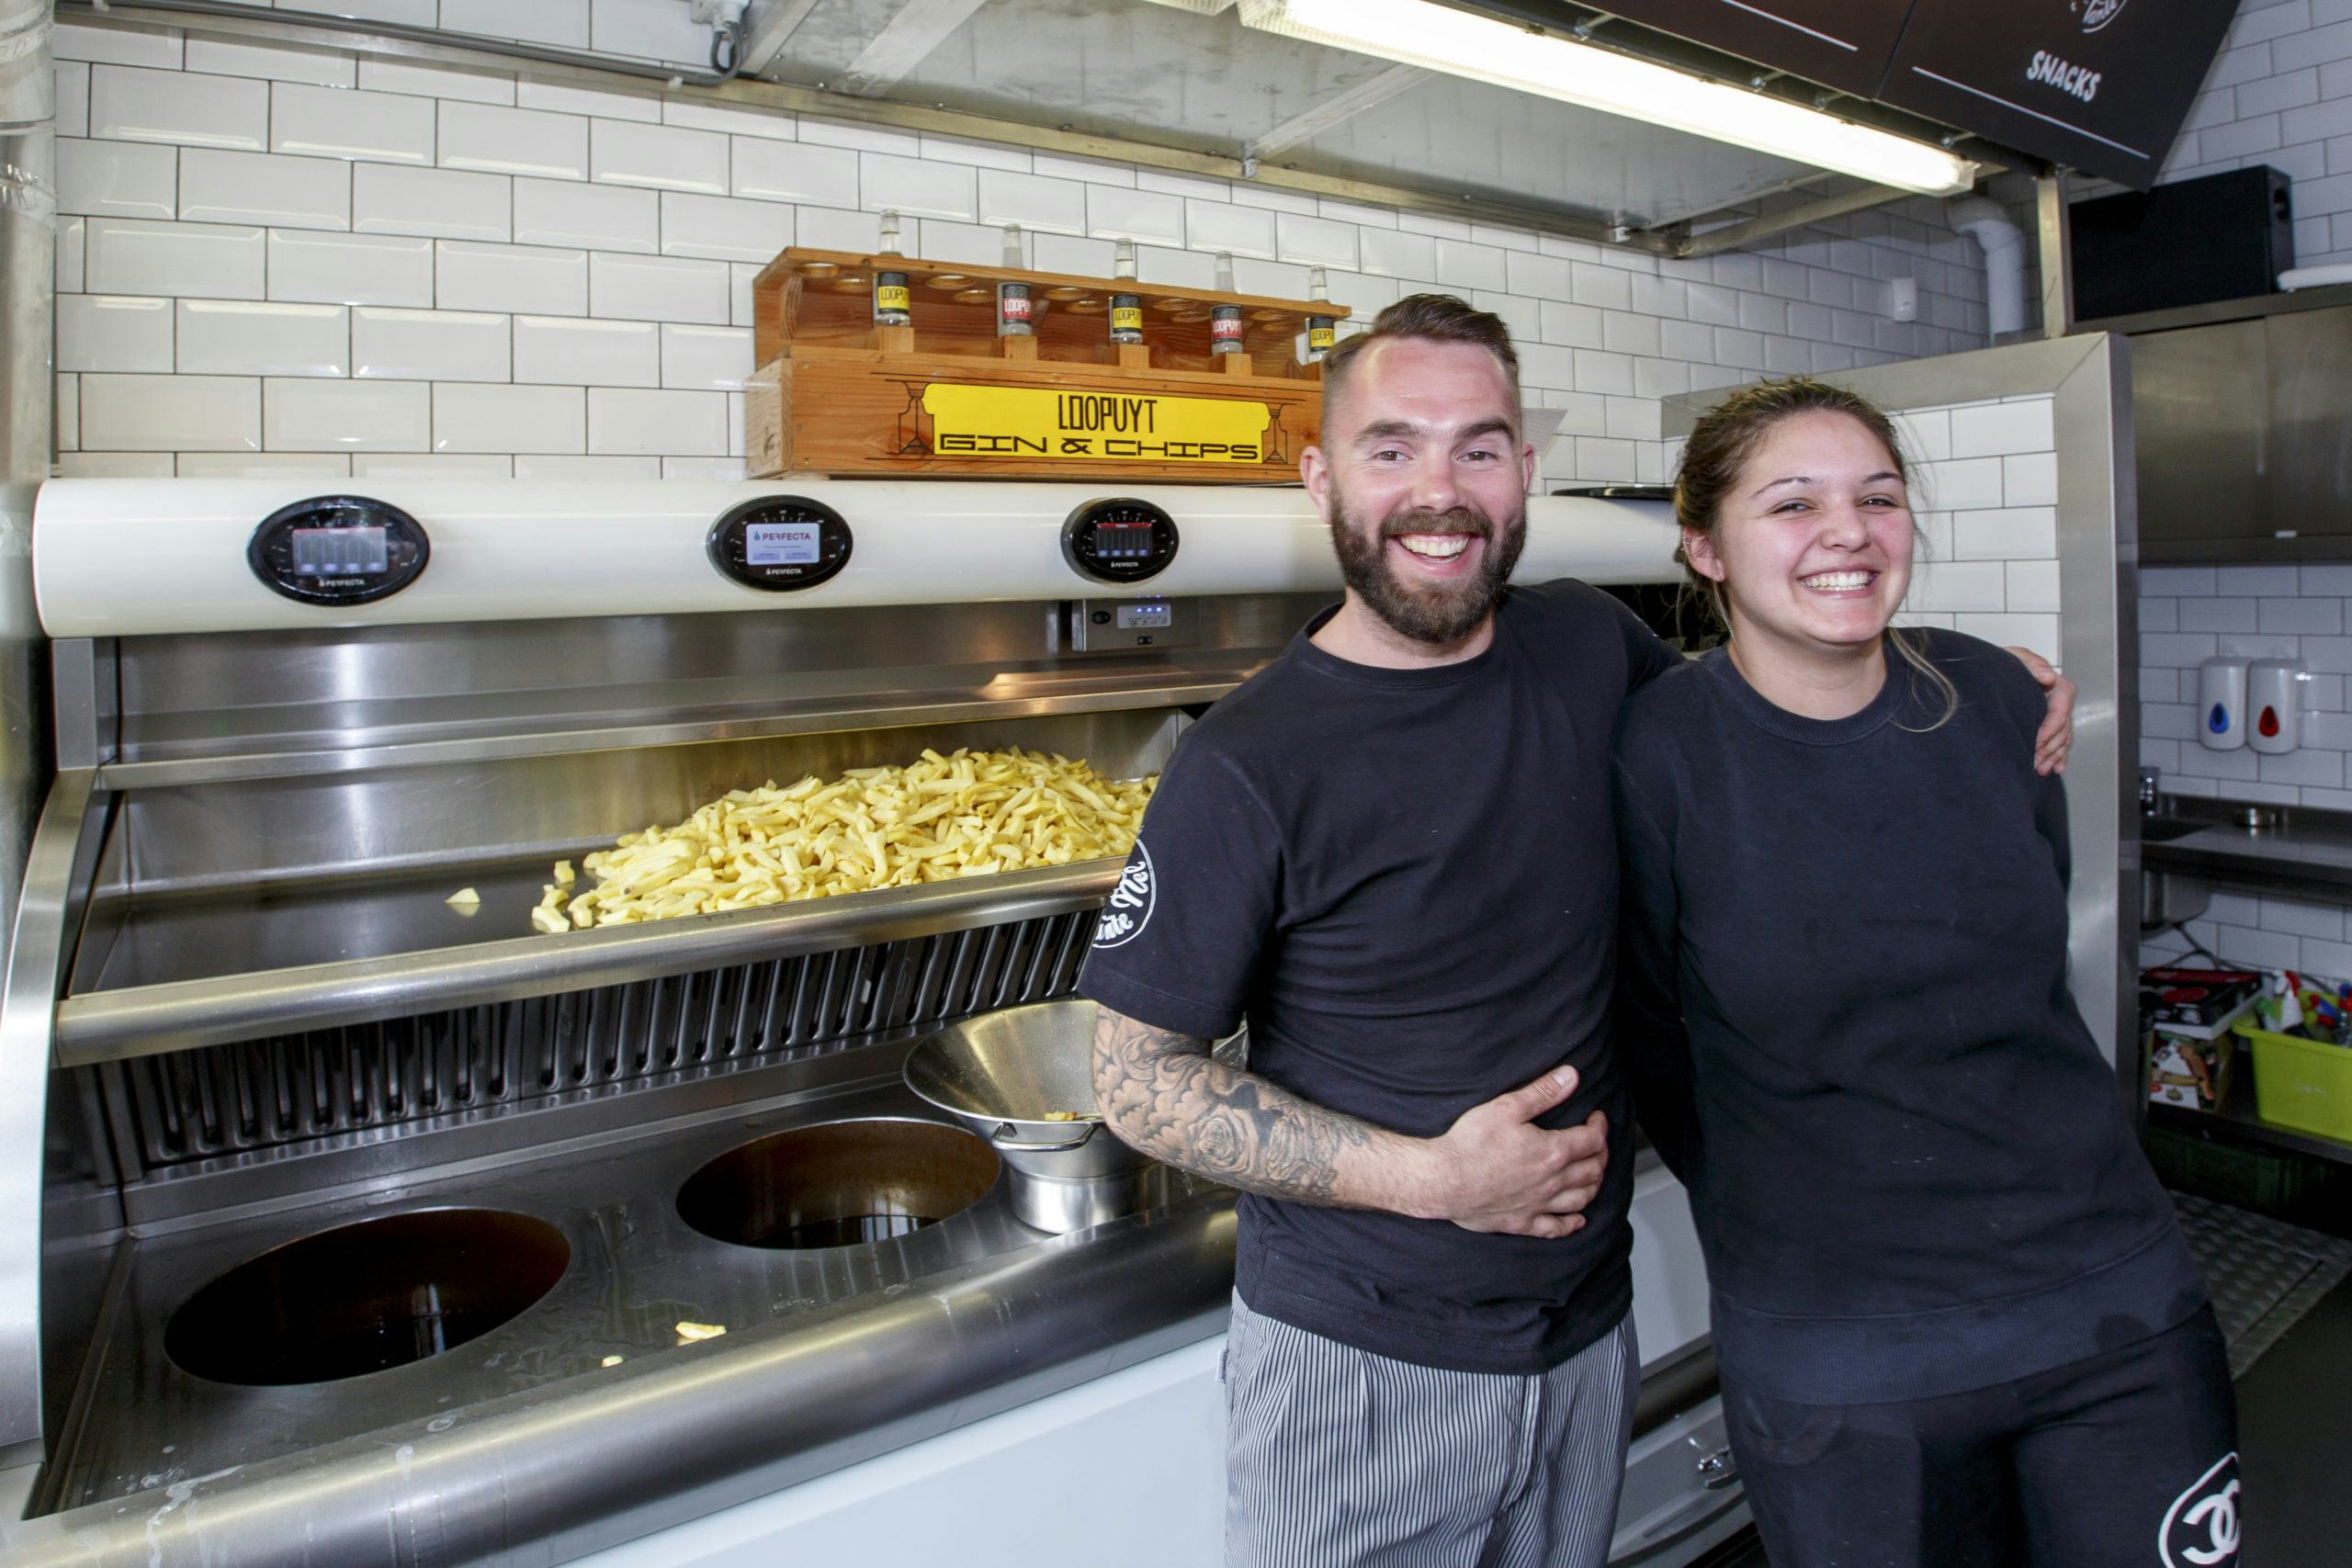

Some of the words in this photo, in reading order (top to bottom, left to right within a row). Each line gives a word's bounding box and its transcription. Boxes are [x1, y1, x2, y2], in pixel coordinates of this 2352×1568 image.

[2026, 50, 2101, 102] SNACKS
[1058, 394, 1158, 434] LOOPUYT
[940, 434, 1047, 453] GIN
[1060, 437, 1093, 455] &
[1105, 439, 1258, 459] CHIPS
[763, 533, 811, 541] PERFECTA
